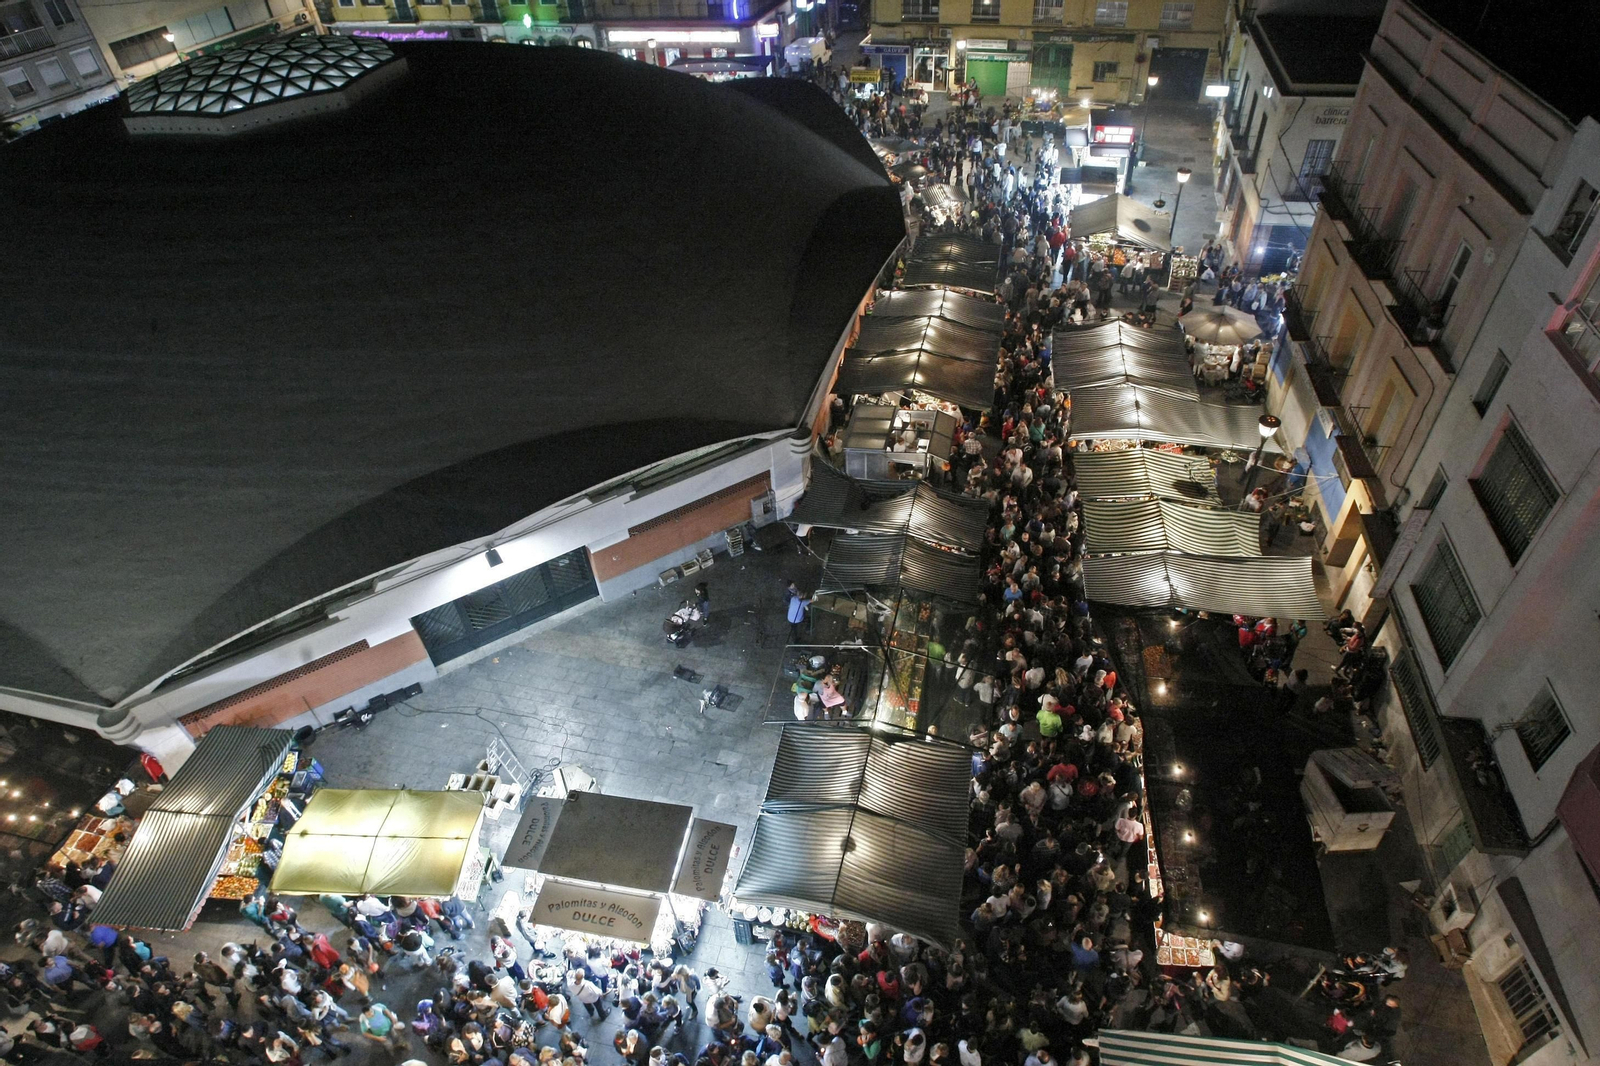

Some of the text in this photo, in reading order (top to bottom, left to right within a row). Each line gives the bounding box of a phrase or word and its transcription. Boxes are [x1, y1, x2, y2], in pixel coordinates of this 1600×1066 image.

[522, 818, 540, 846] DULCE
[704, 844, 720, 874] DULCE
[691, 857, 705, 892] Palomitas
[548, 898, 598, 913] Palomitas
[608, 903, 643, 929] Algodon
[572, 911, 616, 927] DULCE
